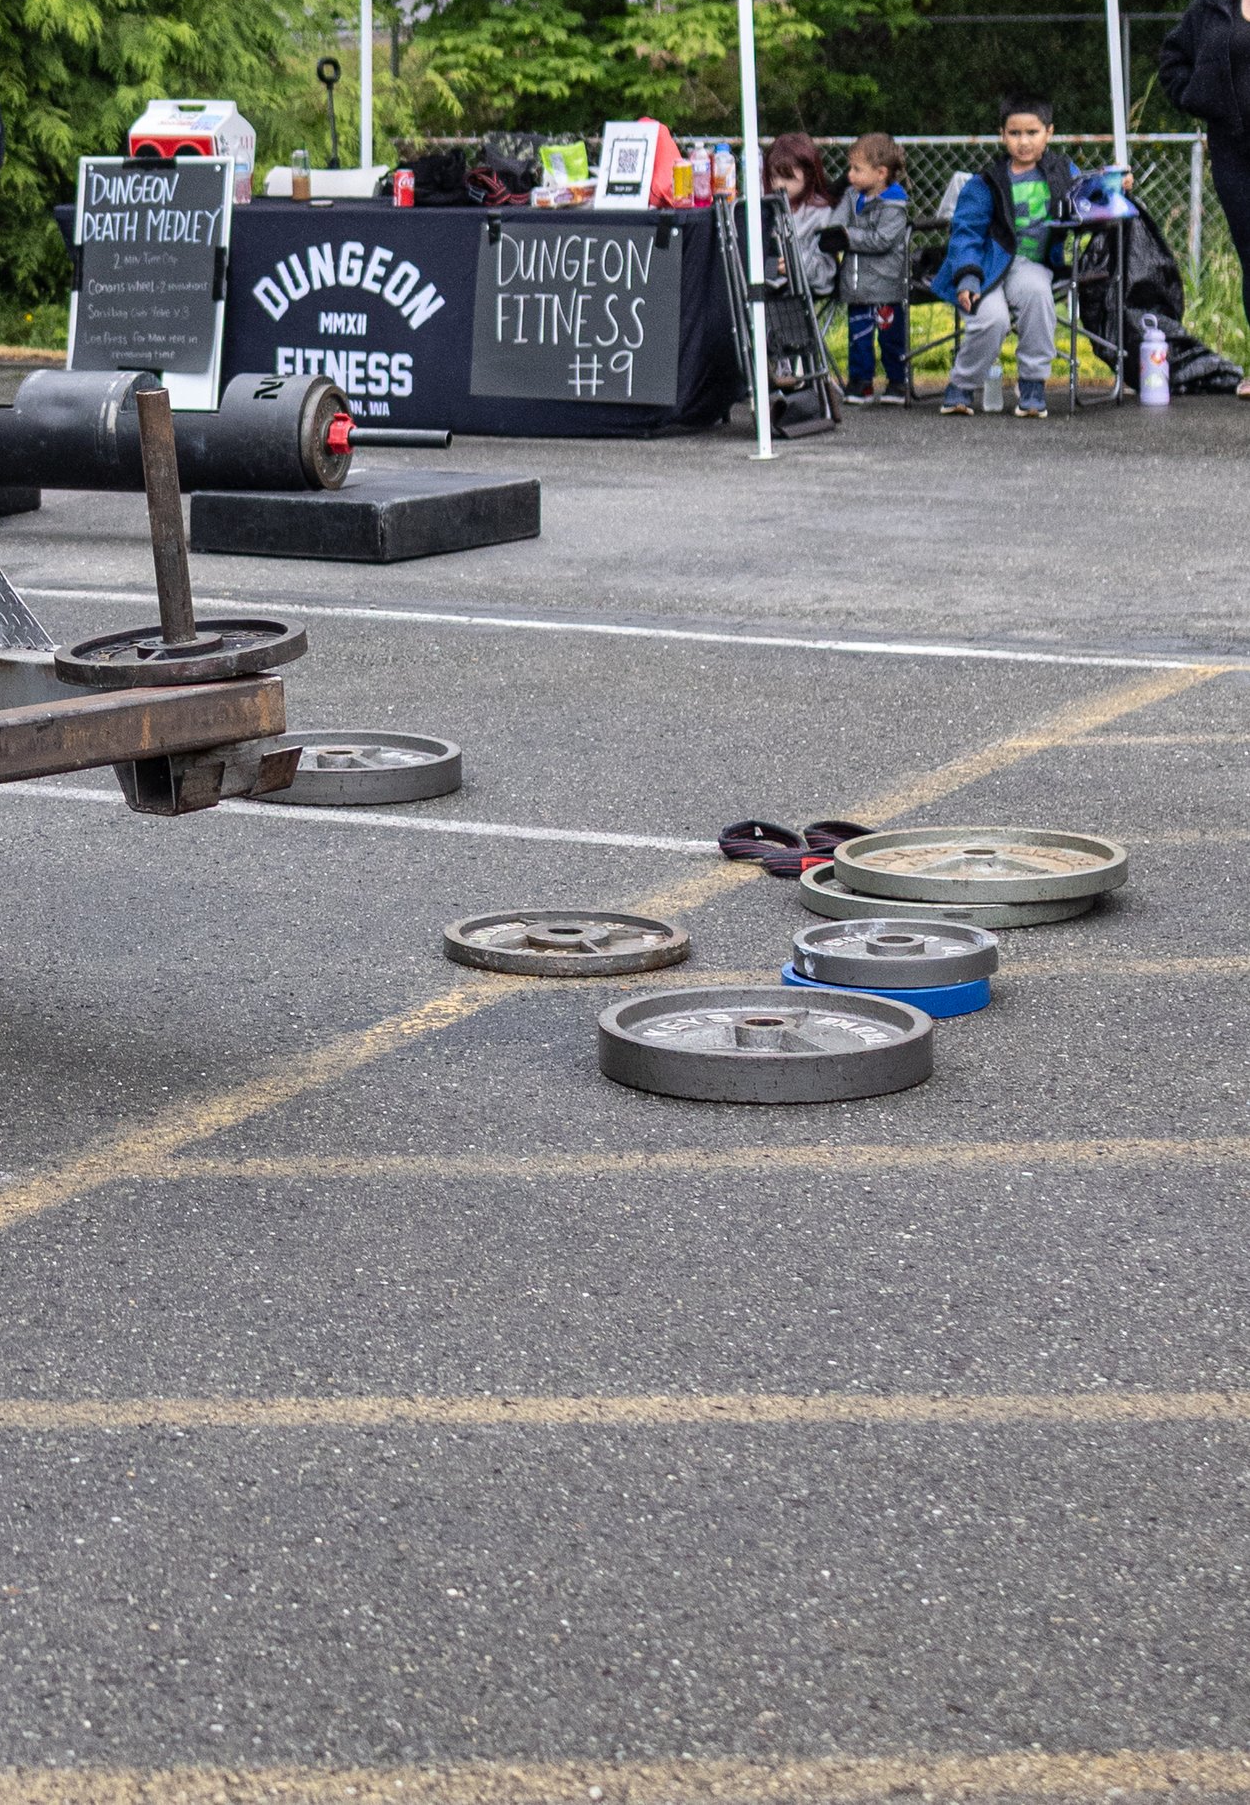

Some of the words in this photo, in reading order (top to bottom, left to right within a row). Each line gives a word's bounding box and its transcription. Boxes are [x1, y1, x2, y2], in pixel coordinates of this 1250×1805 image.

[83, 211, 138, 242] DEATH
[113, 252, 121, 270] 2
[498, 232, 654, 290] DUNGEON
[252, 241, 446, 331] DUNGEON
[319, 311, 367, 336] MMXII
[497, 288, 646, 349] FITNESS
[277, 346, 413, 397] FITNESS
[568, 349, 634, 397] #9
[369, 401, 391, 417] WA
